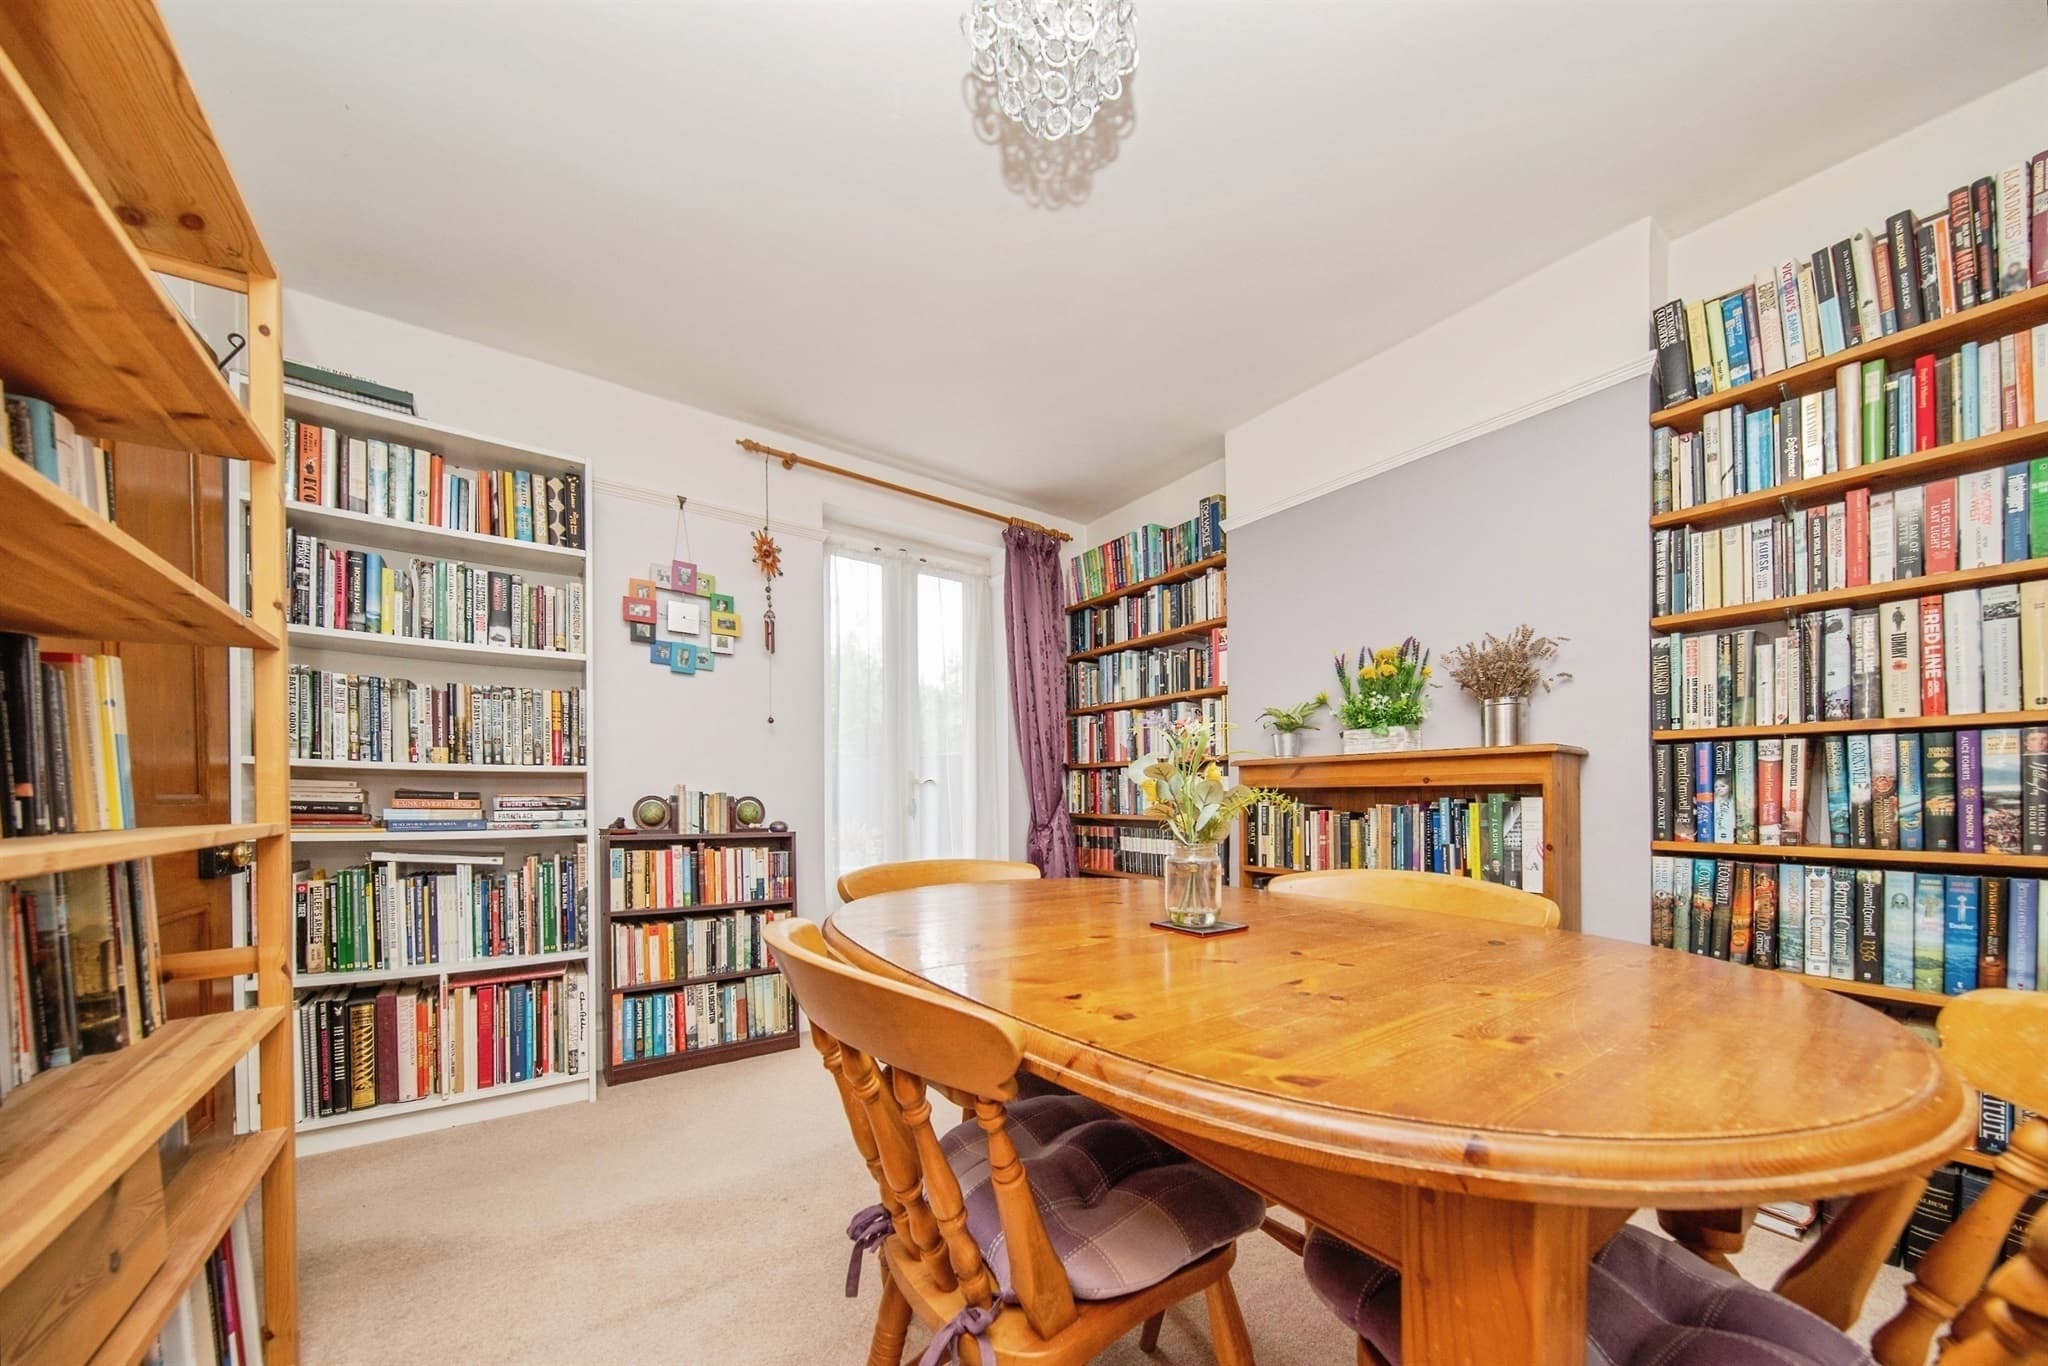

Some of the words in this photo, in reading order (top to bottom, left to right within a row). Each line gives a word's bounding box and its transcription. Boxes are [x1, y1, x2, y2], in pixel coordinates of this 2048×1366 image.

[2003, 169, 2020, 200] ALAN
[2004, 200, 2021, 240] DAVIES
[1782, 263, 1795, 312] VICTORIA'S
[1787, 313, 1800, 347] EMPIRE
[303, 477, 317, 502] ECO
[535, 478, 544, 505] EDDIE
[536, 505, 546, 536] JONES
[1930, 505, 1940, 523] LAST
[1941, 497, 1950, 514] THE
[1201, 519, 1210, 546] WOLFE
[1909, 525, 1919, 539] DAY
[1930, 526, 1940, 549] LIGHT
[1941, 516, 1950, 537] GUNS
[1759, 541, 1768, 572] KURSK
[1910, 541, 1919, 552] OF
[1942, 538, 1950, 549] AT
[1924, 614, 1940, 644] RED
[1891, 632, 1907, 659] TOMMY
[1653, 655, 1670, 695] STALINGRAD
[1925, 645, 1941, 679] LINE
[1961, 737, 1969, 754] ALICE
[1677, 747, 1690, 777] Bernard
[1851, 742, 1867, 786] CORNWELL
[1962, 755, 1970, 780] ROBERTS
[1678, 776, 1690, 810] Cornwell
[1966, 804, 1974, 837] DOMINATION
[2029, 806, 2037, 835] HOLMES
[2038, 804, 2046, 837] RICHARD
[1716, 865, 1730, 904] CORNWELL
[1810, 879, 1825, 916] Bernard
[1834, 881, 1850, 918] Bernard
[1863, 883, 1875, 908] Bernard
[314, 886, 322, 917] HITLER'S
[314, 919, 322, 944] ARMIES
[1810, 917, 1825, 957] Cornwell
[1863, 908, 1875, 936] Cornwell
[1834, 919, 1850, 960] Cornwell
[1859, 940, 1877, 962] 1356
[707, 984, 715, 996] LEN
[1982, 1092, 2005, 1141] ITUTE
